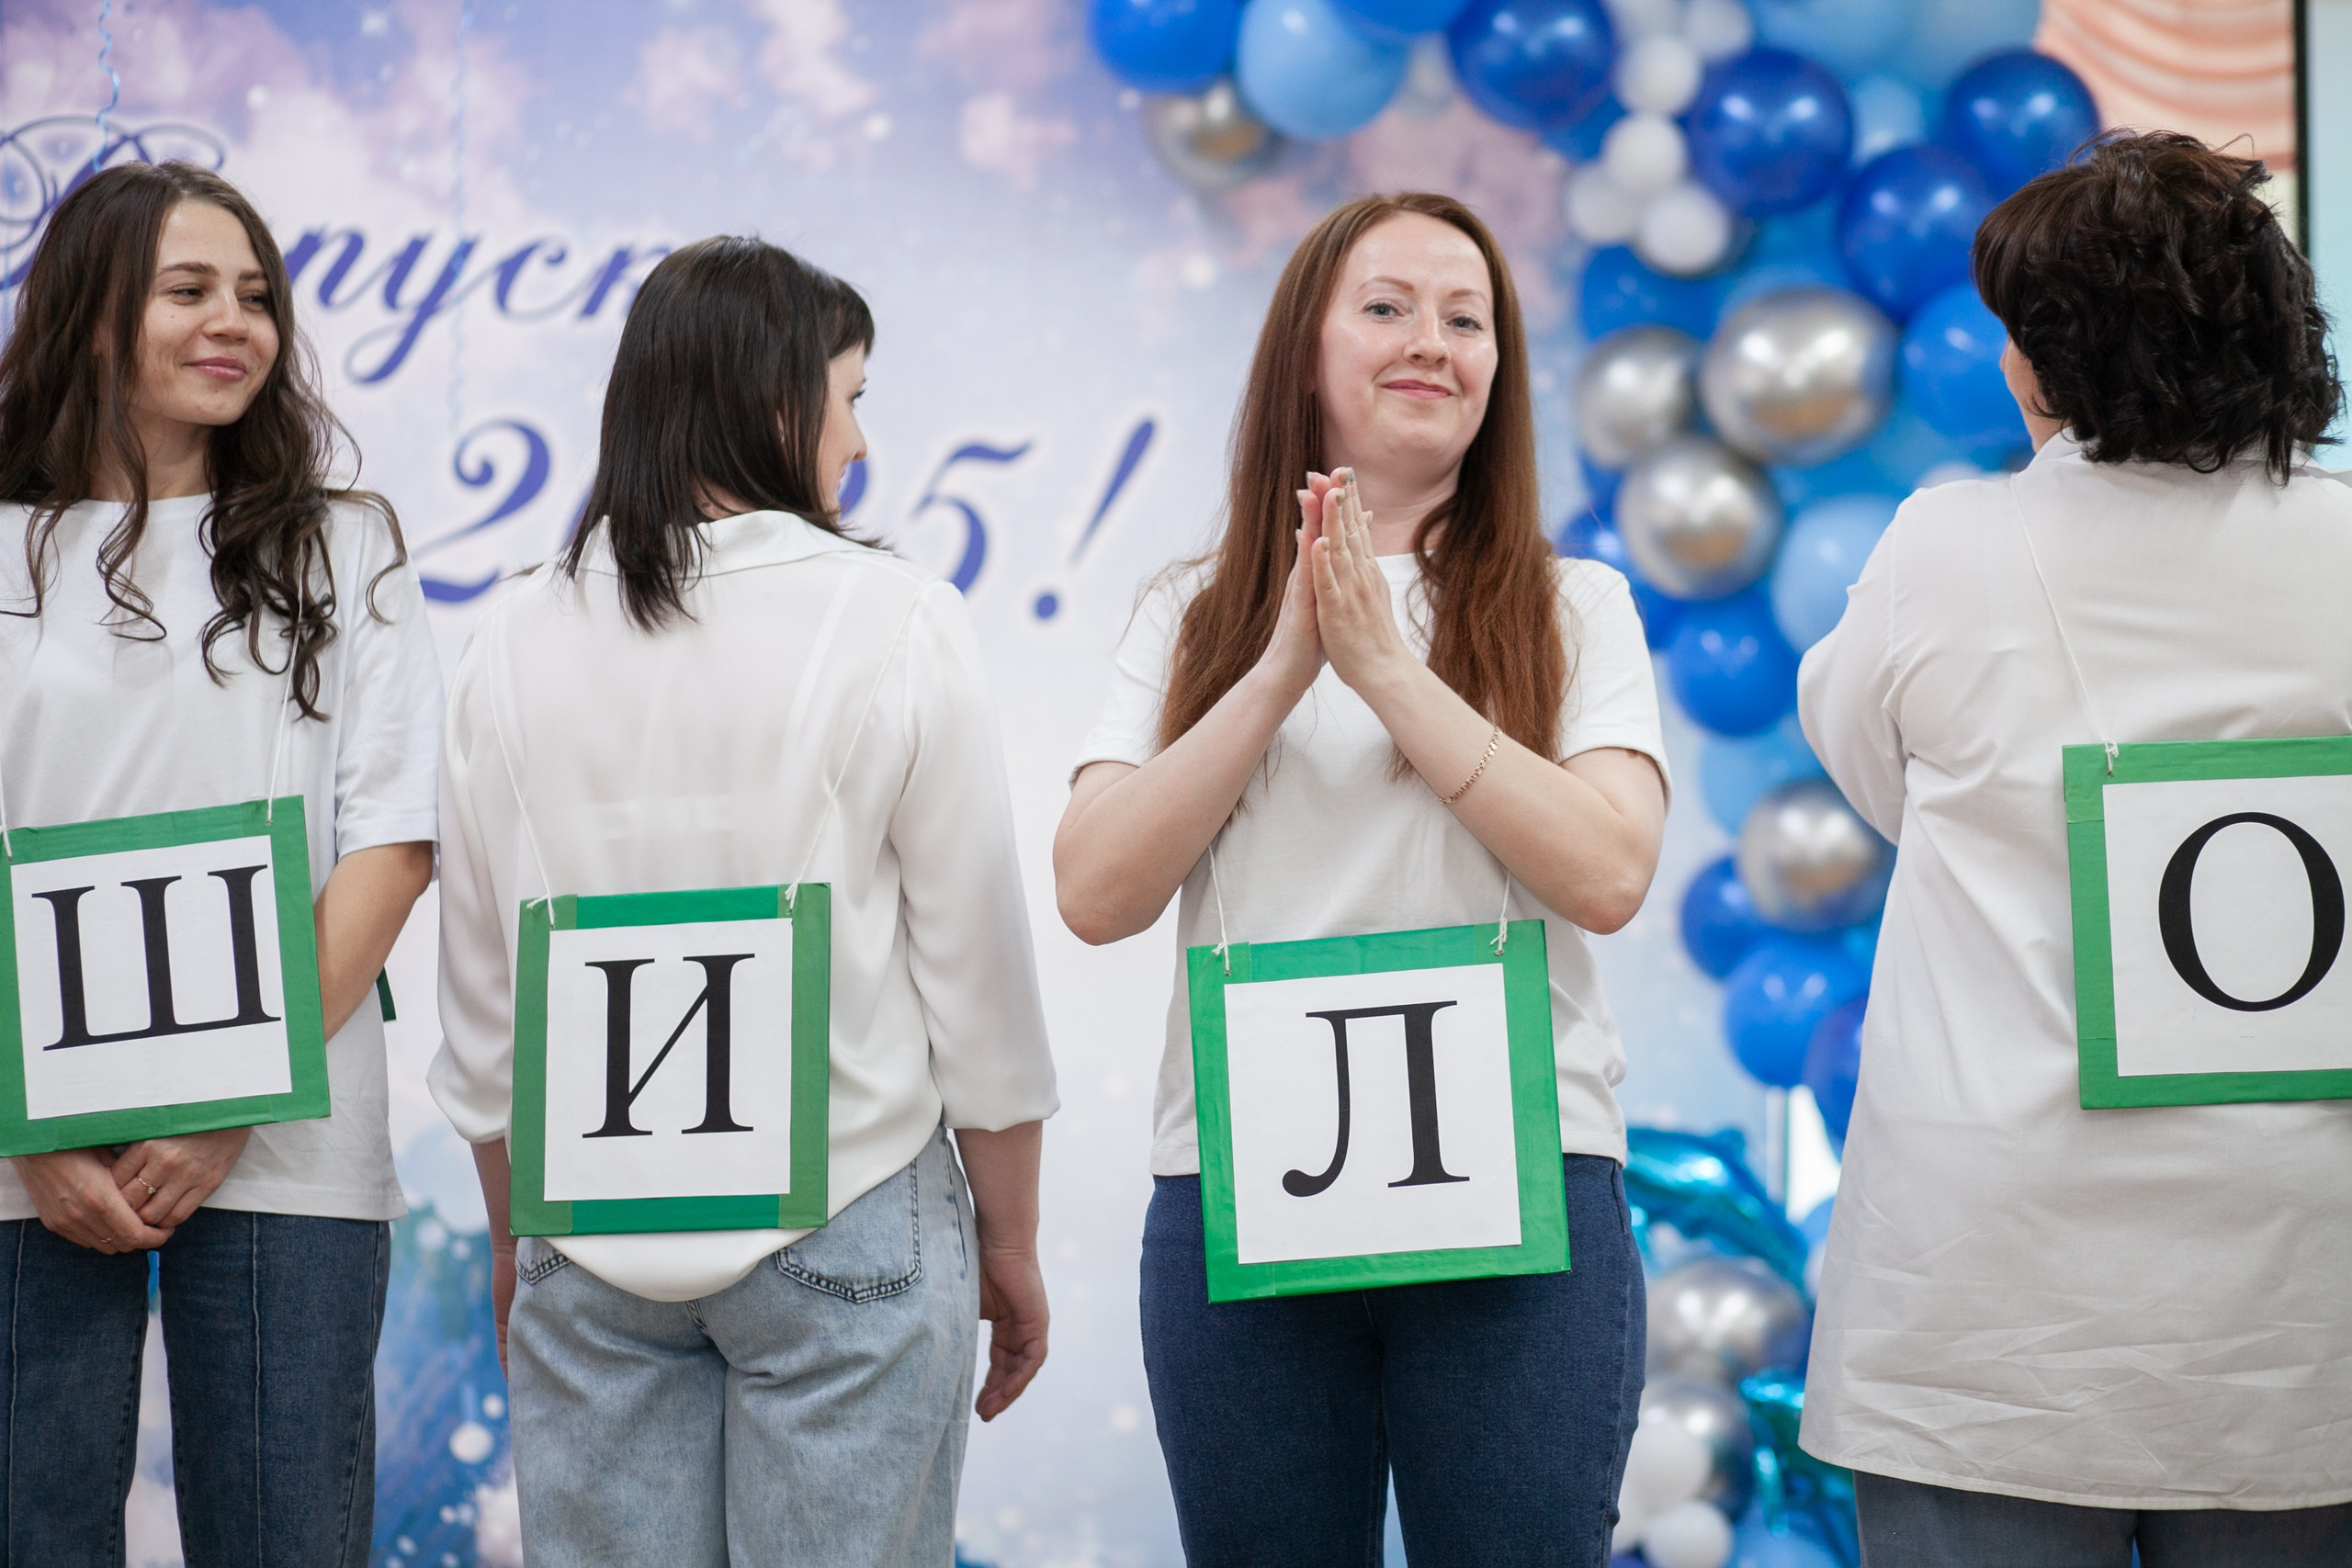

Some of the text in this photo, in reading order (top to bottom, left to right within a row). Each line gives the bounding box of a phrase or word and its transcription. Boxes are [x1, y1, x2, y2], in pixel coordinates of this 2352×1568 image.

[418, 418, 1159, 622] 25!
[31, 863, 282, 1052] Ш
[2159, 811, 2346, 1012] О
[582, 953, 756, 1139] И
[1282, 999, 1471, 1198] Л
